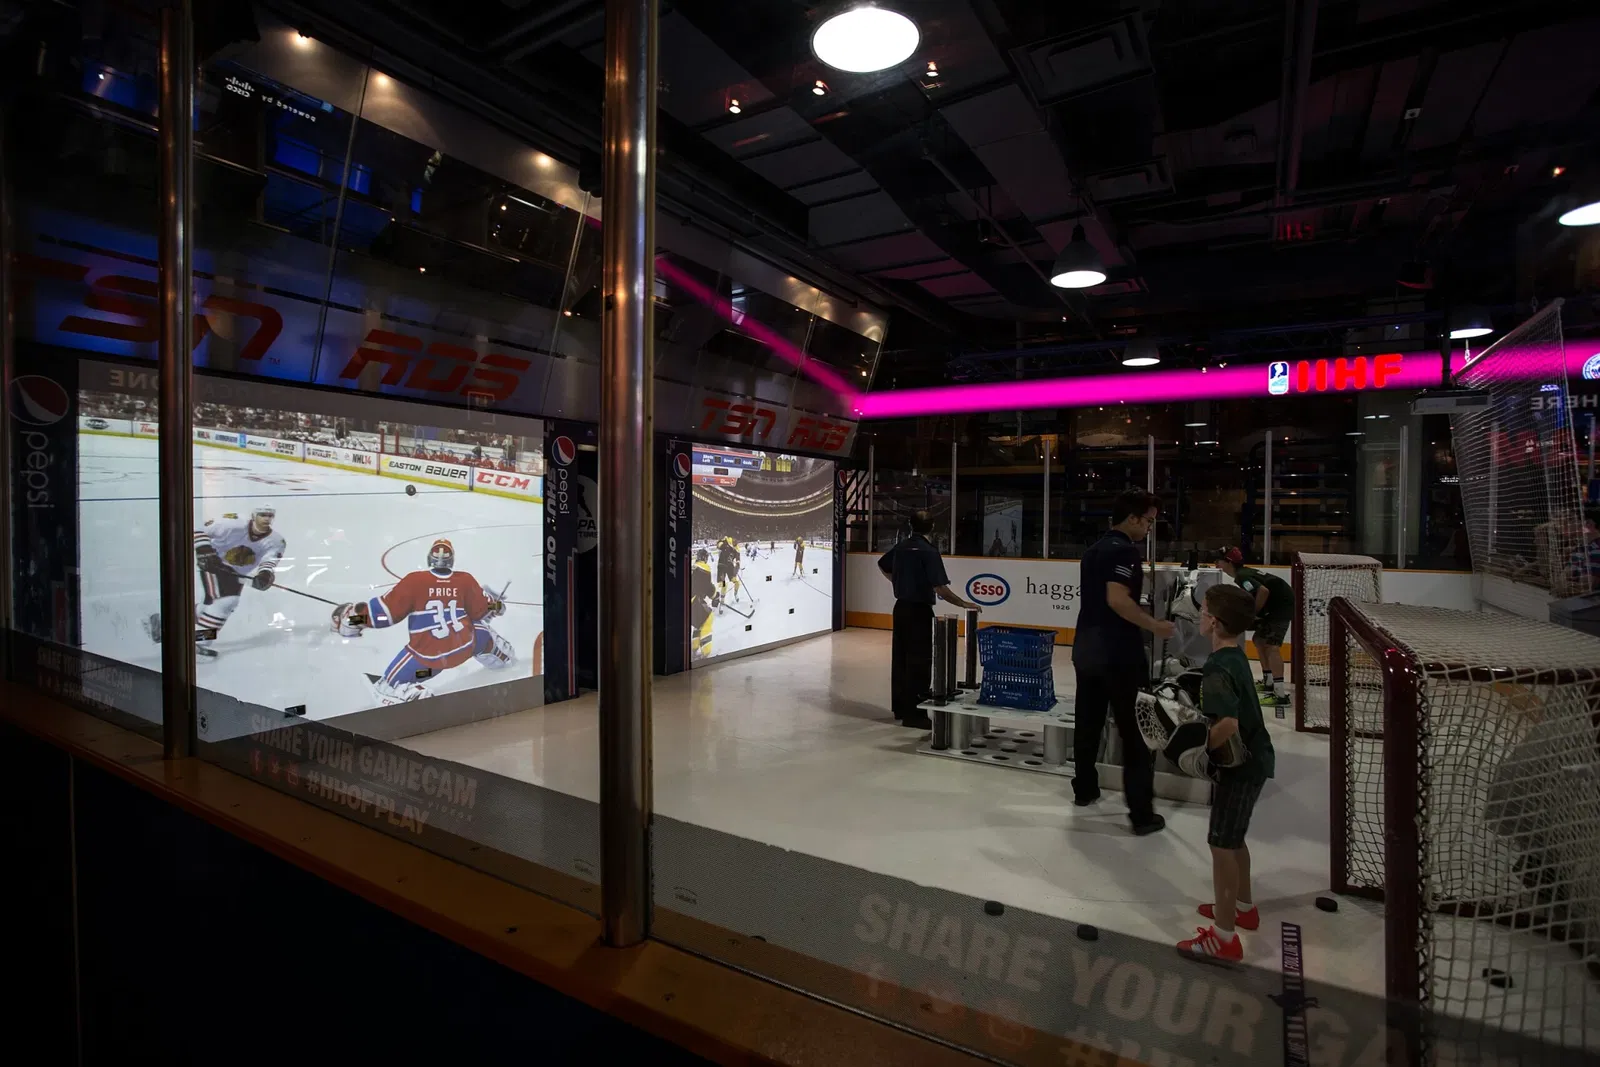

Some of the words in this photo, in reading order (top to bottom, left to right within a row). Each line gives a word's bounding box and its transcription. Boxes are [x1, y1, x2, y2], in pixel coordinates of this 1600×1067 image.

[339, 329, 532, 401] RDS
[1297, 353, 1403, 393] IIHF
[700, 398, 776, 439] TSN
[787, 417, 850, 451] RDS
[20, 430, 55, 508] pepsi
[388, 460, 422, 472] EASTON
[476, 471, 530, 490] CCM
[558, 468, 570, 514] pepsi
[668, 477, 677, 533] SHUT
[677, 480, 687, 519] pepsi
[546, 536, 557, 586] OUT
[668, 536, 677, 578] OUT
[428, 587, 458, 597] PRICE
[425, 599, 464, 639] 31
[251, 713, 303, 755] SHARE
[307, 729, 354, 774] YOUR
[358, 745, 478, 810] GAMECAM
[306, 770, 430, 835] #HHOFPLAY
[855, 897, 1051, 995] SHARE
[1064, 946, 1265, 1058] YOUR
